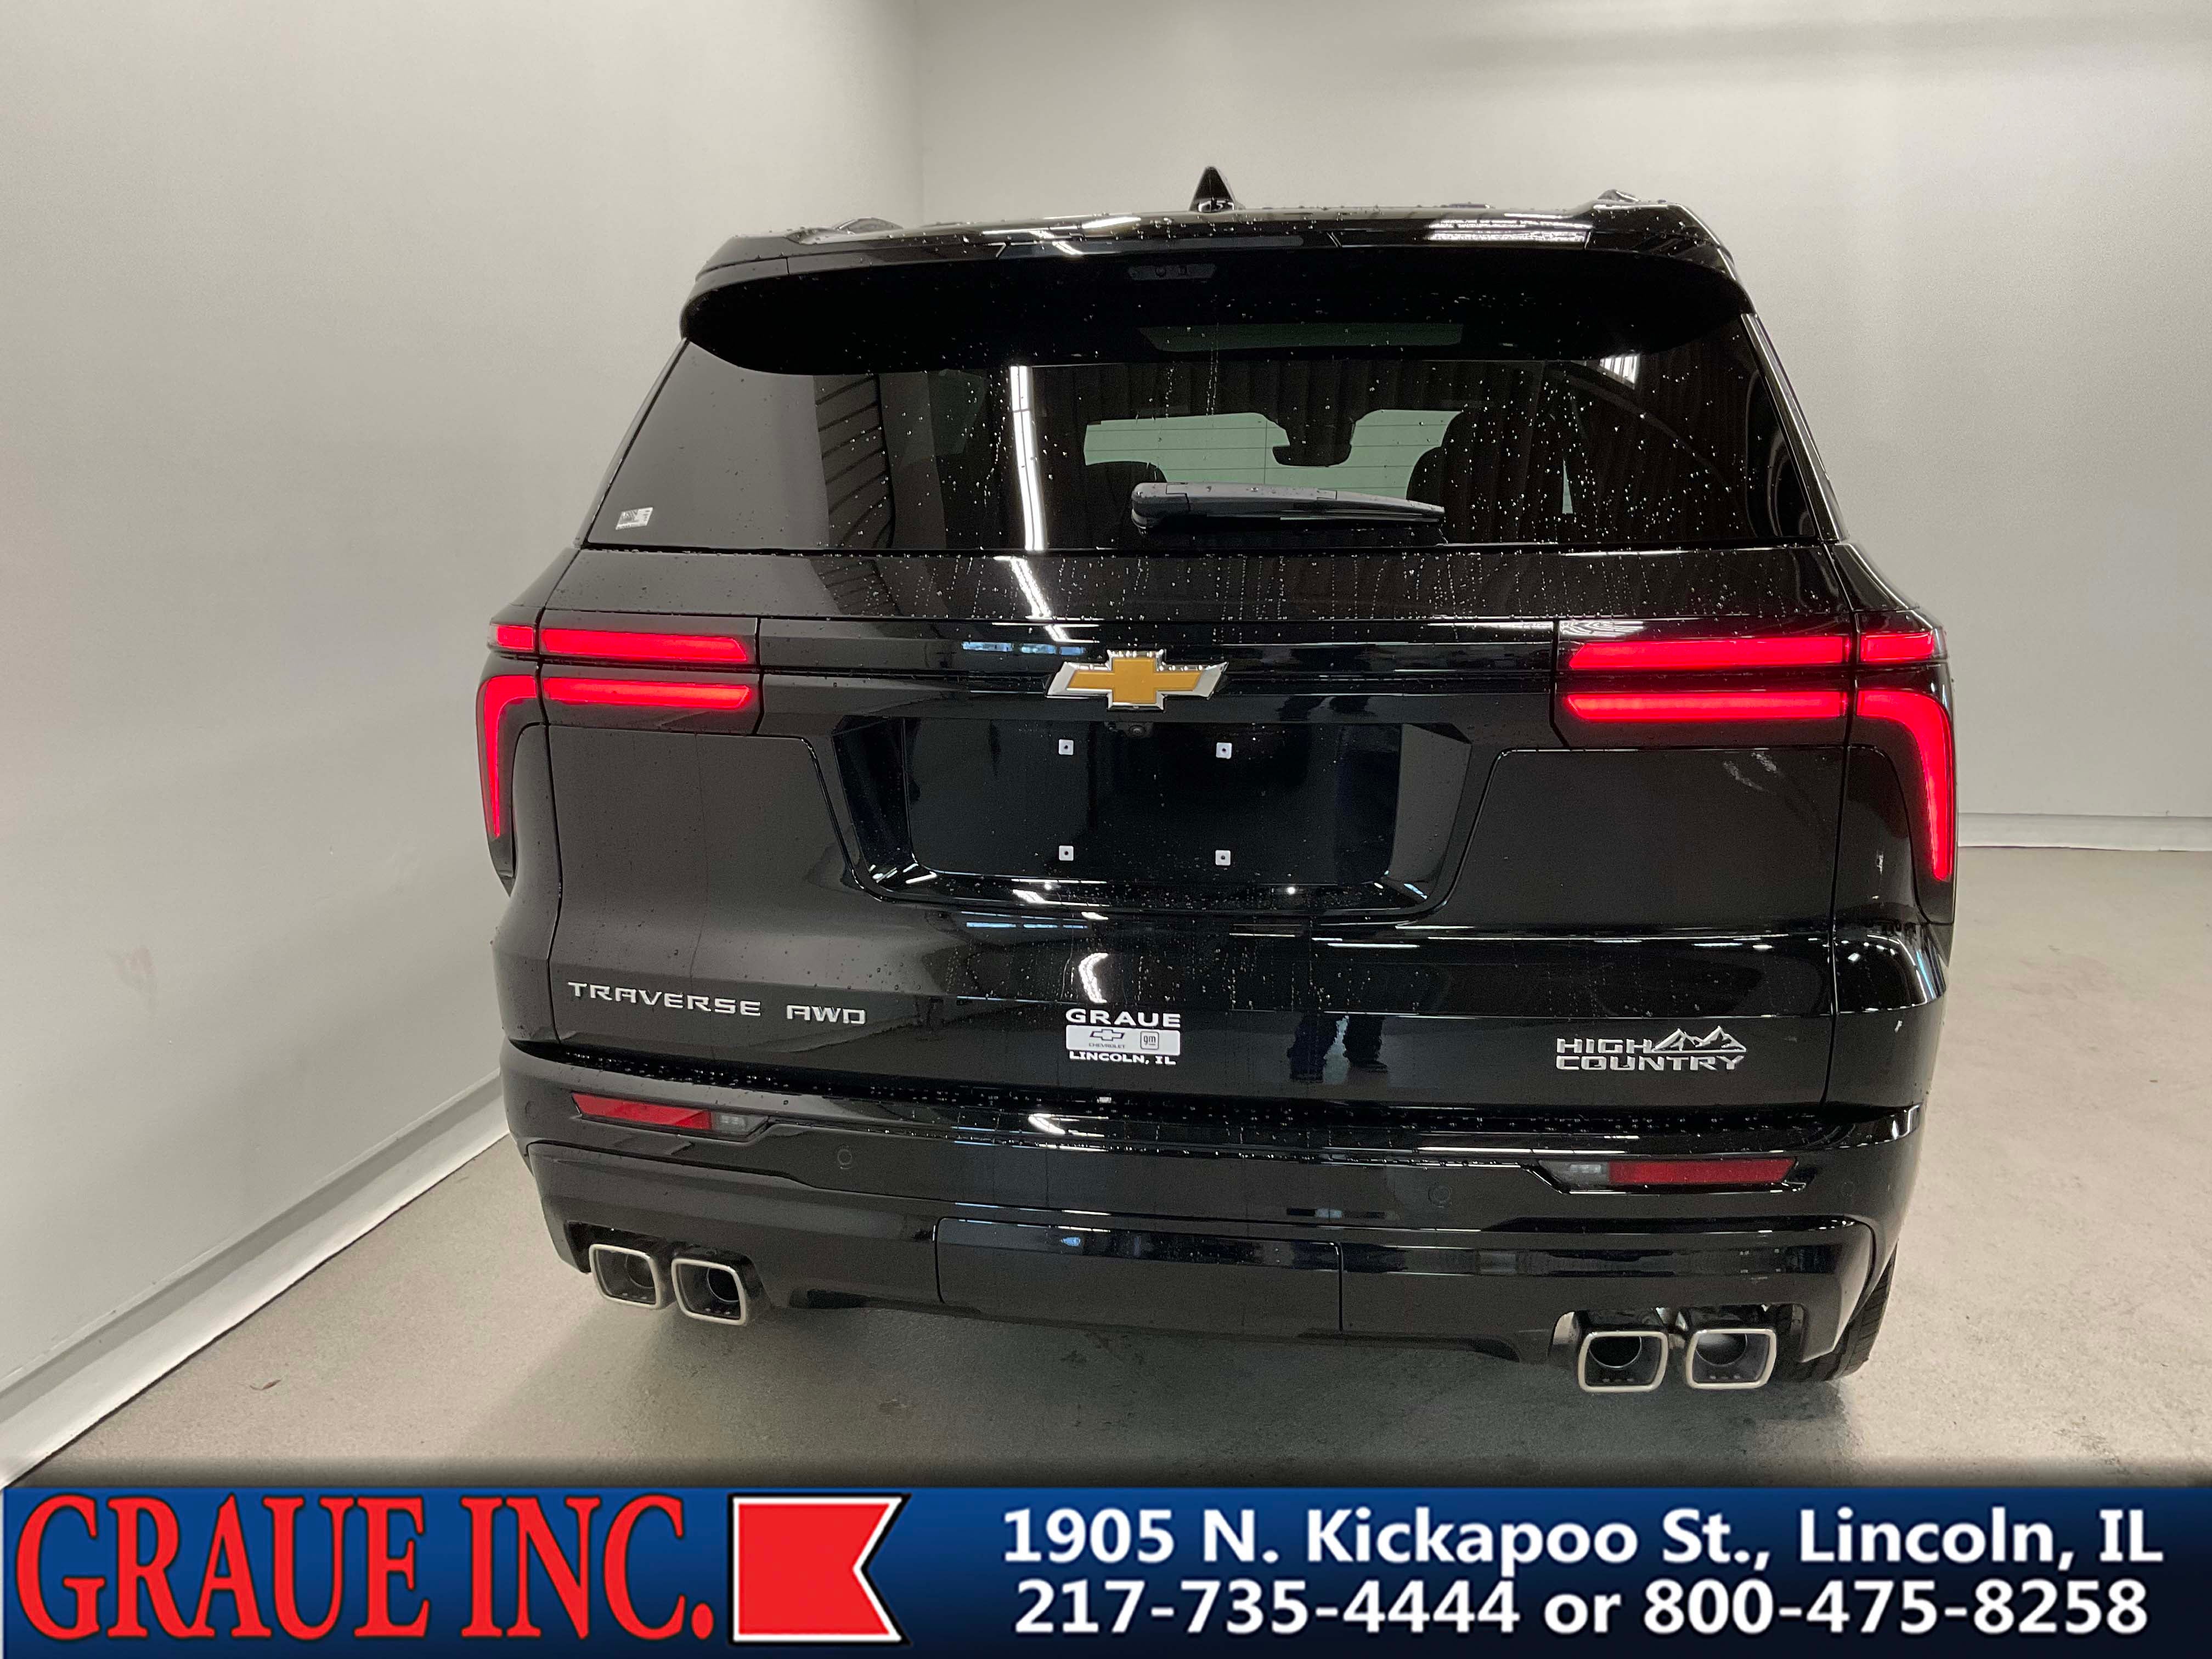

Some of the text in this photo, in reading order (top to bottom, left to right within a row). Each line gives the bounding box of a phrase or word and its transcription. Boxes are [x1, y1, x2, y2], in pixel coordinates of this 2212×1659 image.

[567, 981, 866, 1025] TRAVERSE AWD
[1065, 1008, 1181, 1028] GRAUE
[1556, 1037, 1652, 1054] HIGH
[1069, 1051, 1176, 1065] LINCOLN, IL
[1556, 1054, 1745, 1071] COUNTRY
